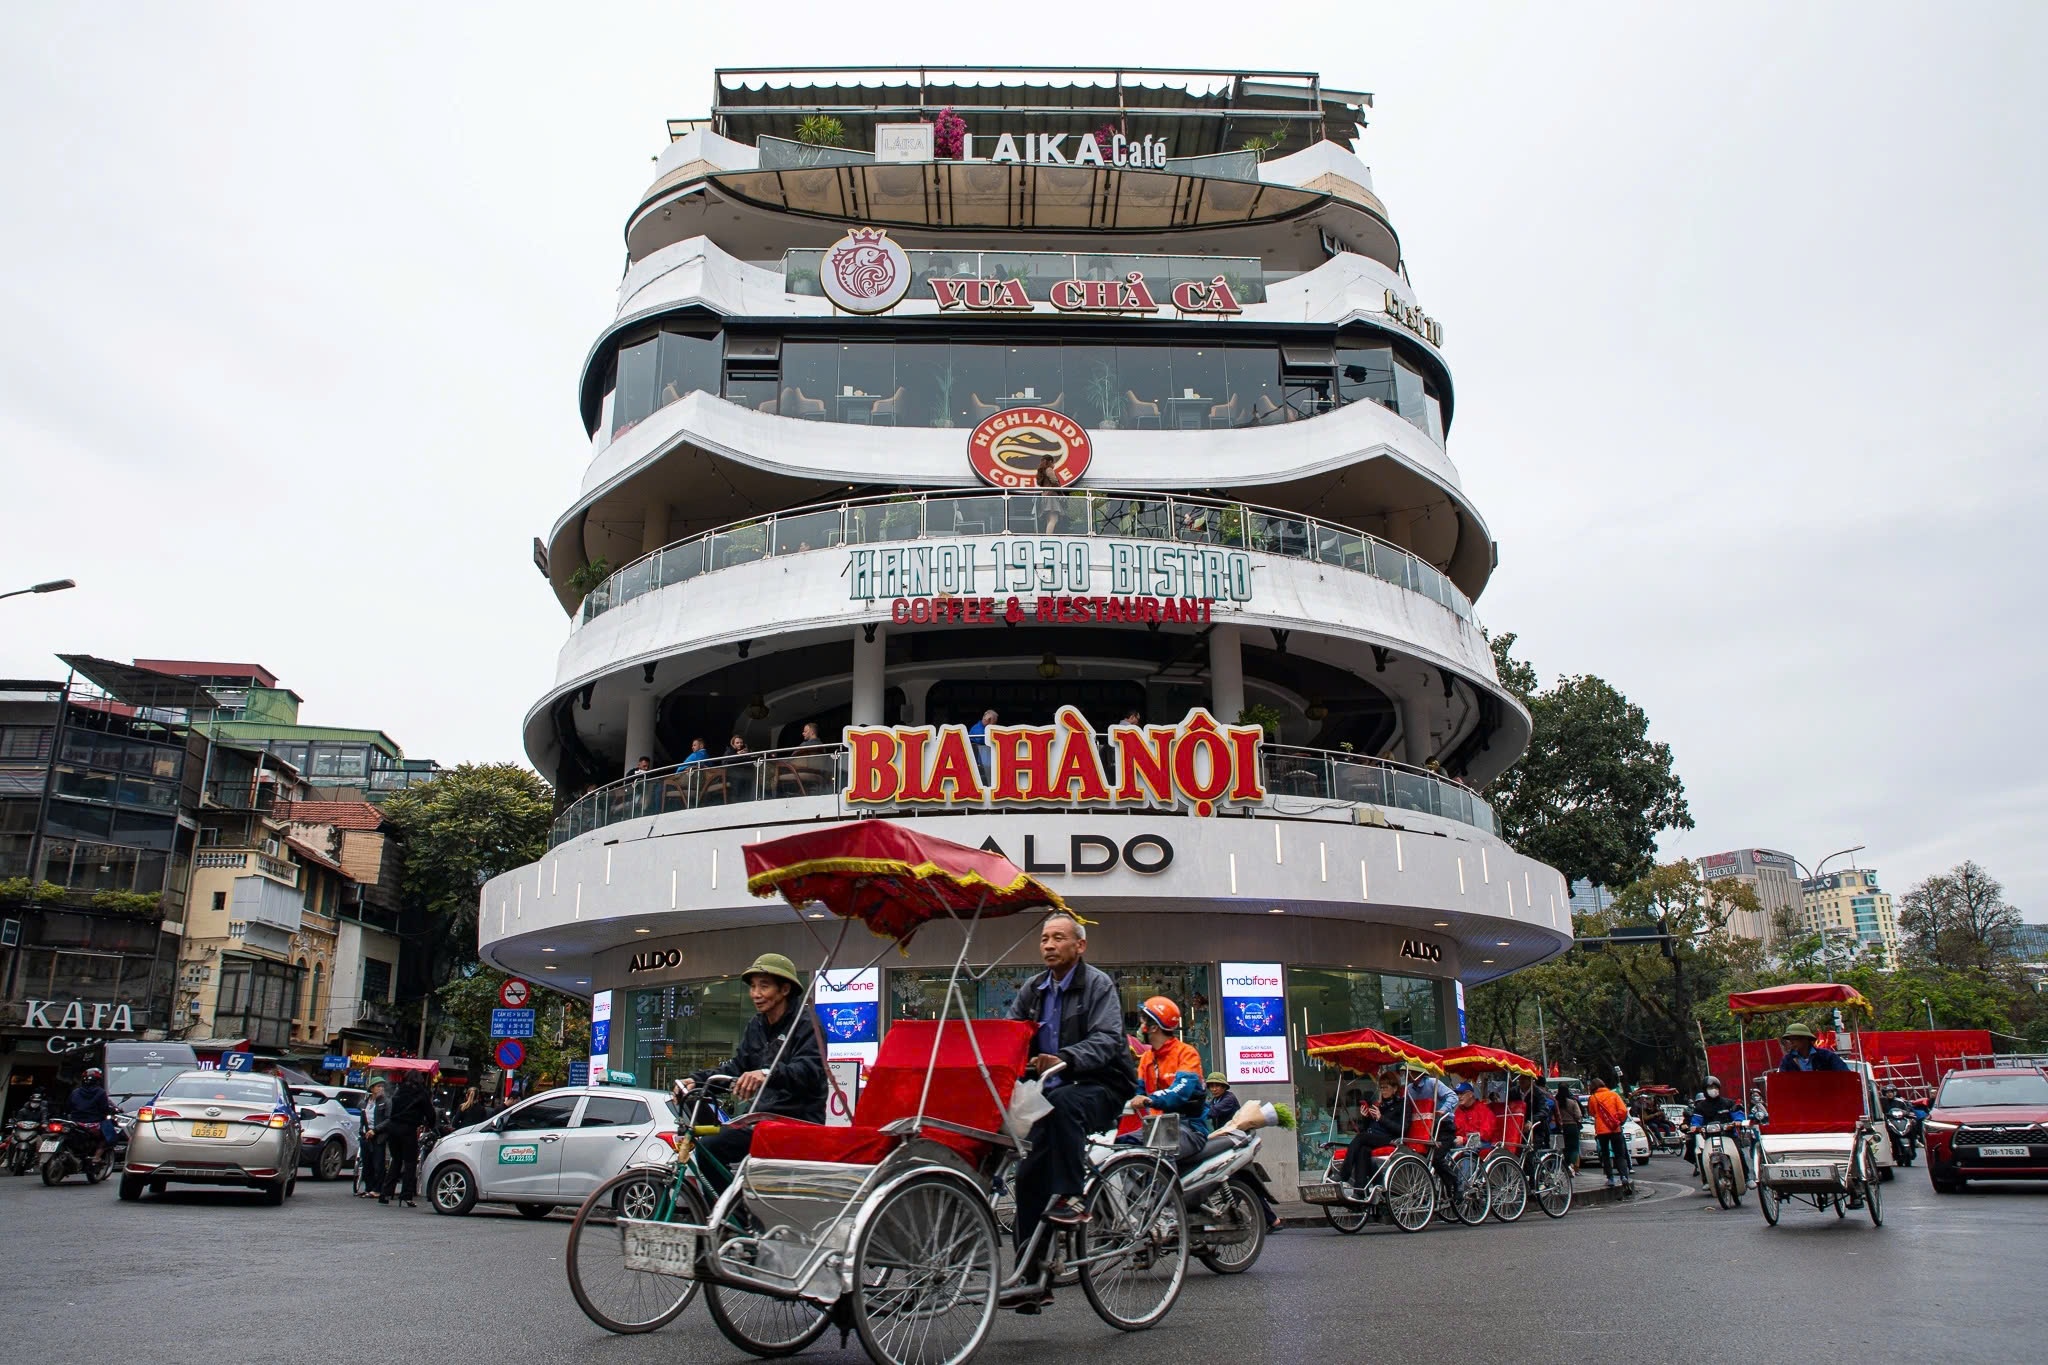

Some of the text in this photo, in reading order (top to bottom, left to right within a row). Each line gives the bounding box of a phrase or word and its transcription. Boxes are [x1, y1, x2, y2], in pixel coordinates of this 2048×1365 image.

[964, 133, 1168, 168] LAIKA Café
[928, 272, 1243, 315] VUA CHẢ CÁ
[975, 412, 1084, 448] HIGHLANDS
[989, 468, 1073, 487] COFE
[850, 541, 1252, 602] HANOI 1930 BISTRO
[892, 596, 1216, 624] COFFEE & RESTAURANT
[846, 708, 1265, 818] BIA HÀ NỘI
[1706, 865, 1737, 878] GROUP
[628, 949, 682, 973] ALDO
[1400, 939, 1442, 963] ALDO
[1226, 975, 1278, 986] mobifone
[22, 1000, 134, 1032] KAFA
[228, 1054, 245, 1070] G7
[1252, 1064, 1275, 1074] NƯỚC
[1780, 1169, 1821, 1178] 29XL-0125
